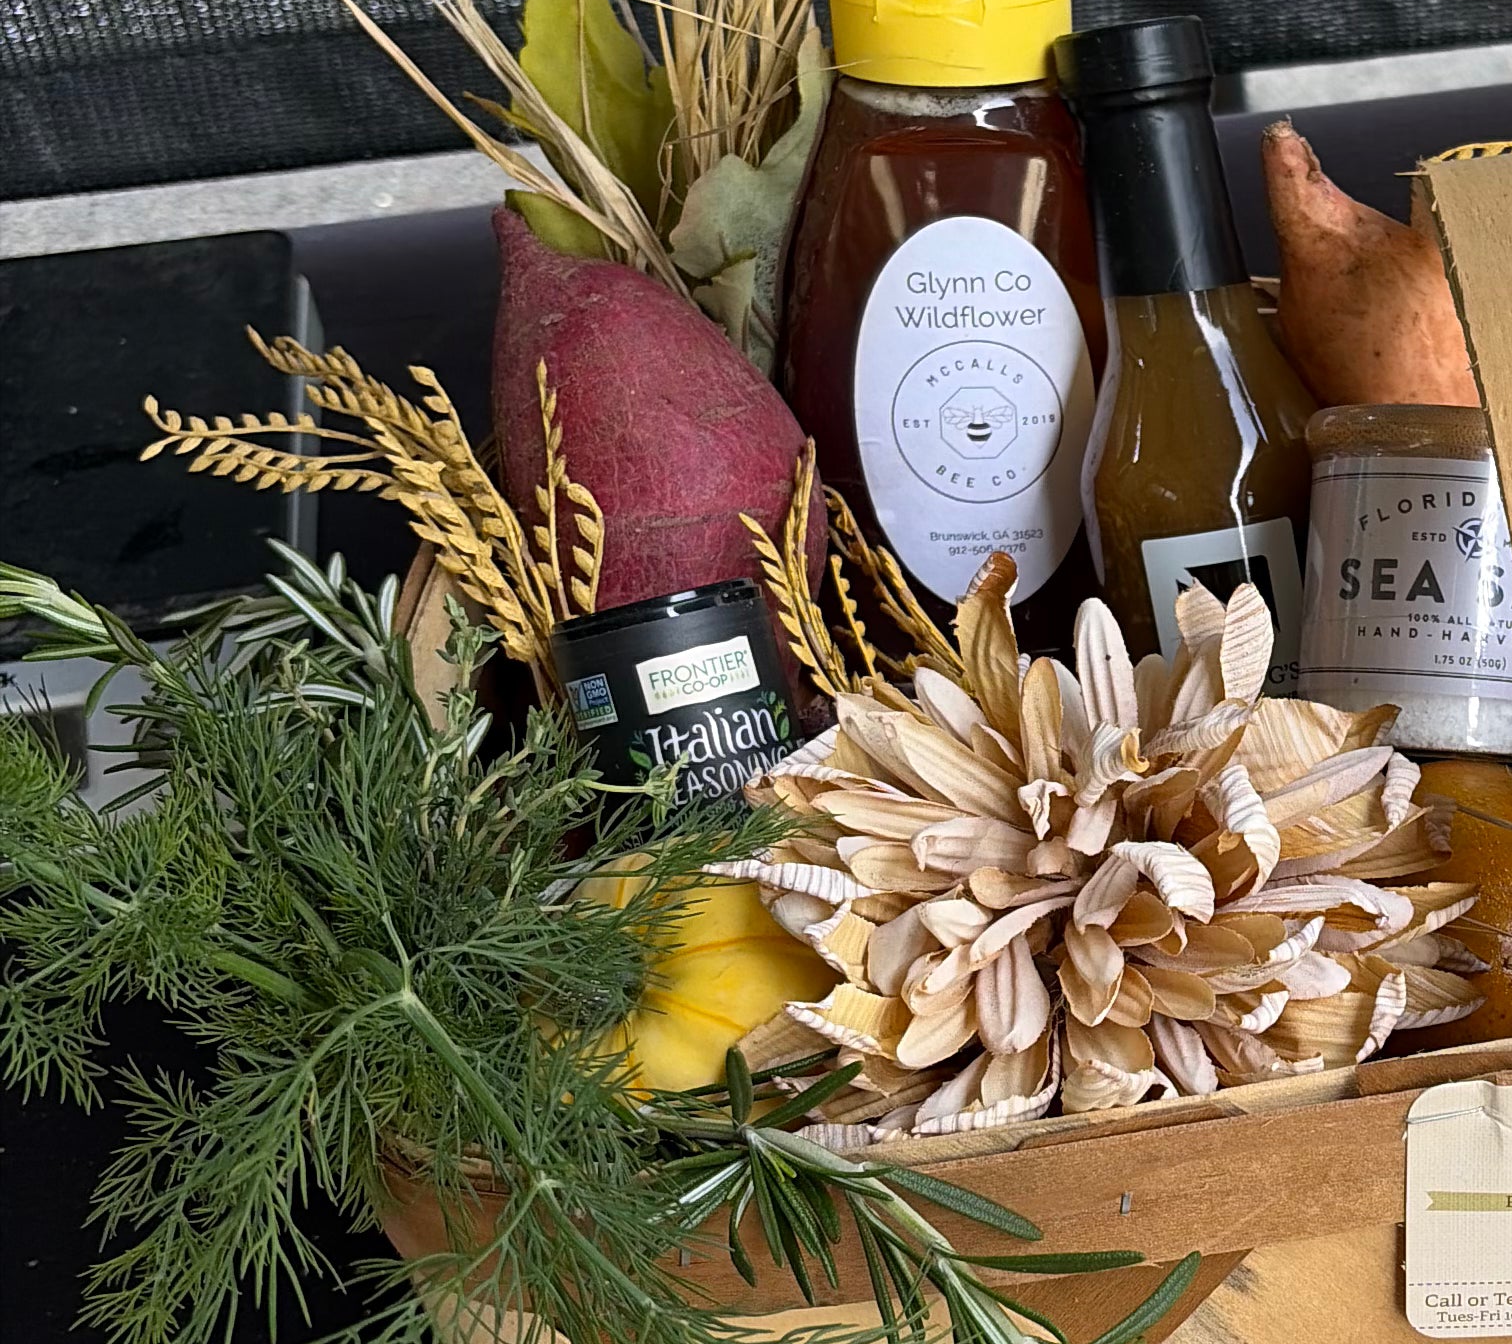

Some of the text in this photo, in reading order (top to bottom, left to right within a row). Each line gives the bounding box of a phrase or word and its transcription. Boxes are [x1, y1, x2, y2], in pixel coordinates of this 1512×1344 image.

[906, 270, 1031, 300] Glynn Co
[895, 306, 1047, 328] Wildflower
[925, 358, 1024, 387] MCCALLS
[903, 414, 1056, 428] EST 2019
[935, 464, 975, 488] BEE
[1358, 492, 1476, 531] FLORID
[992, 530, 1010, 540] GA
[1412, 531, 1446, 543] ESTD
[1339, 558, 1445, 603] SEA
[1408, 613, 1440, 624] 100%
[1448, 616, 1472, 626] ALL
[1434, 654, 1454, 665] 1.75
[1459, 656, 1472, 666] OZ
[648, 650, 745, 690] FRONTIER
[583, 678, 604, 691] NON
[682, 673, 728, 695] CO-OP
[586, 687, 607, 700] GMO
[645, 707, 779, 765] Italian
[1425, 1293, 1462, 1307] Call
[1467, 1295, 1488, 1307] or
[1437, 1309, 1501, 1323] Tues-Fri
